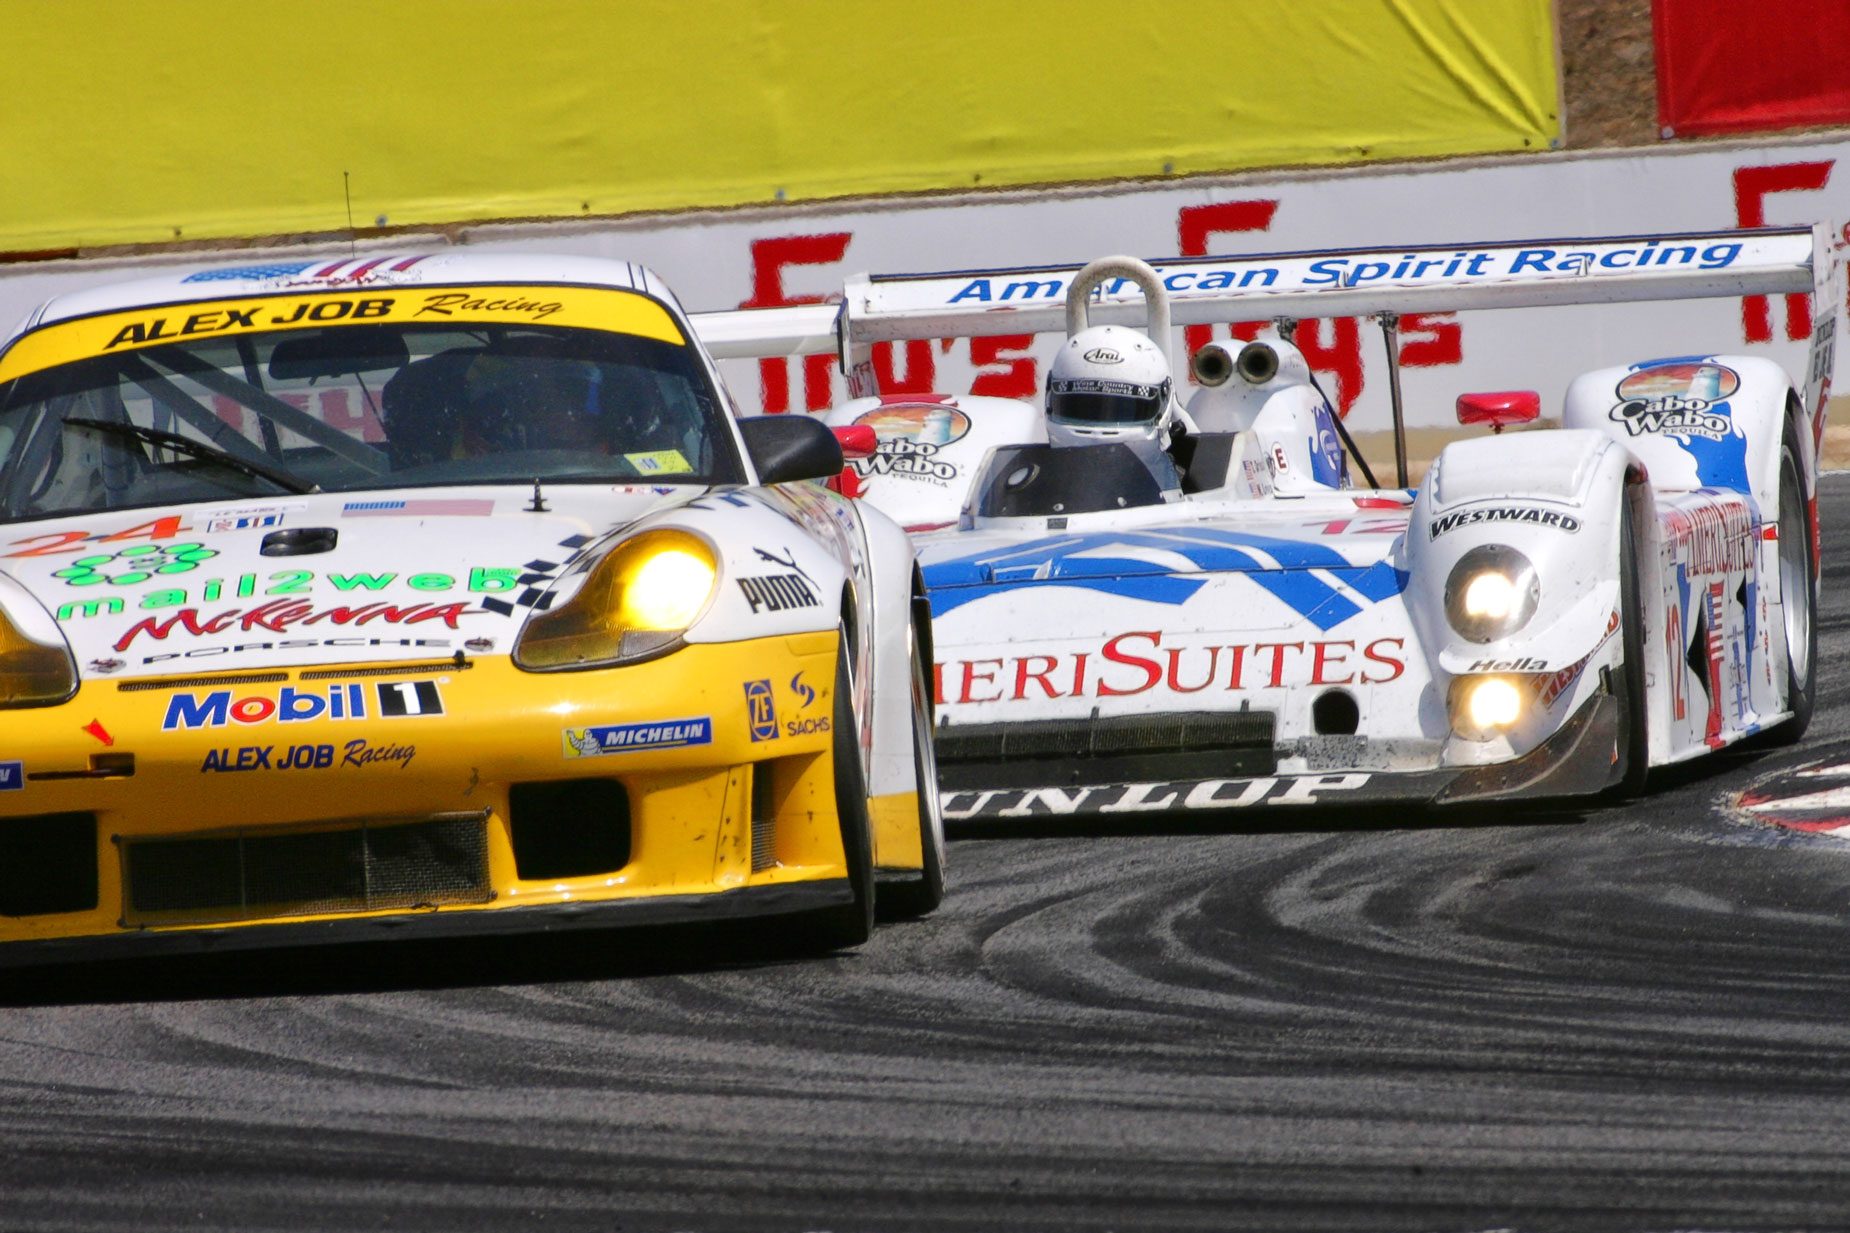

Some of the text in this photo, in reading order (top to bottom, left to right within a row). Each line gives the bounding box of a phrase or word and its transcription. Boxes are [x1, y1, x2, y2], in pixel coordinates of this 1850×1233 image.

[1301, 251, 1495, 287] Spirit
[1508, 241, 1744, 275] Racing
[103, 293, 565, 351] ALEX JOB Racing
[1175, 200, 1463, 421] Frys
[1087, 348, 1120, 361] Arai
[1609, 395, 1710, 422] Cabo
[1623, 411, 1728, 437] Wabo
[1662, 428, 1719, 440] TEQUILA
[876, 437, 938, 456] abo
[849, 454, 957, 480] Wabo
[891, 473, 949, 488] TEQUILA
[1430, 508, 1579, 539] WESTWARD
[57, 567, 522, 620] mail2web
[736, 574, 819, 614] PUMA
[143, 638, 451, 664] PORSCHE
[1468, 657, 1549, 672] Hella
[934, 630, 1406, 705] ERISUITES
[161, 683, 367, 730] Mobil
[605, 722, 704, 746] MICHELIN
[787, 717, 831, 737] SACHS
[202, 738, 417, 773] ALEX JOB Racing
[940, 773, 1373, 819] UNLOP
